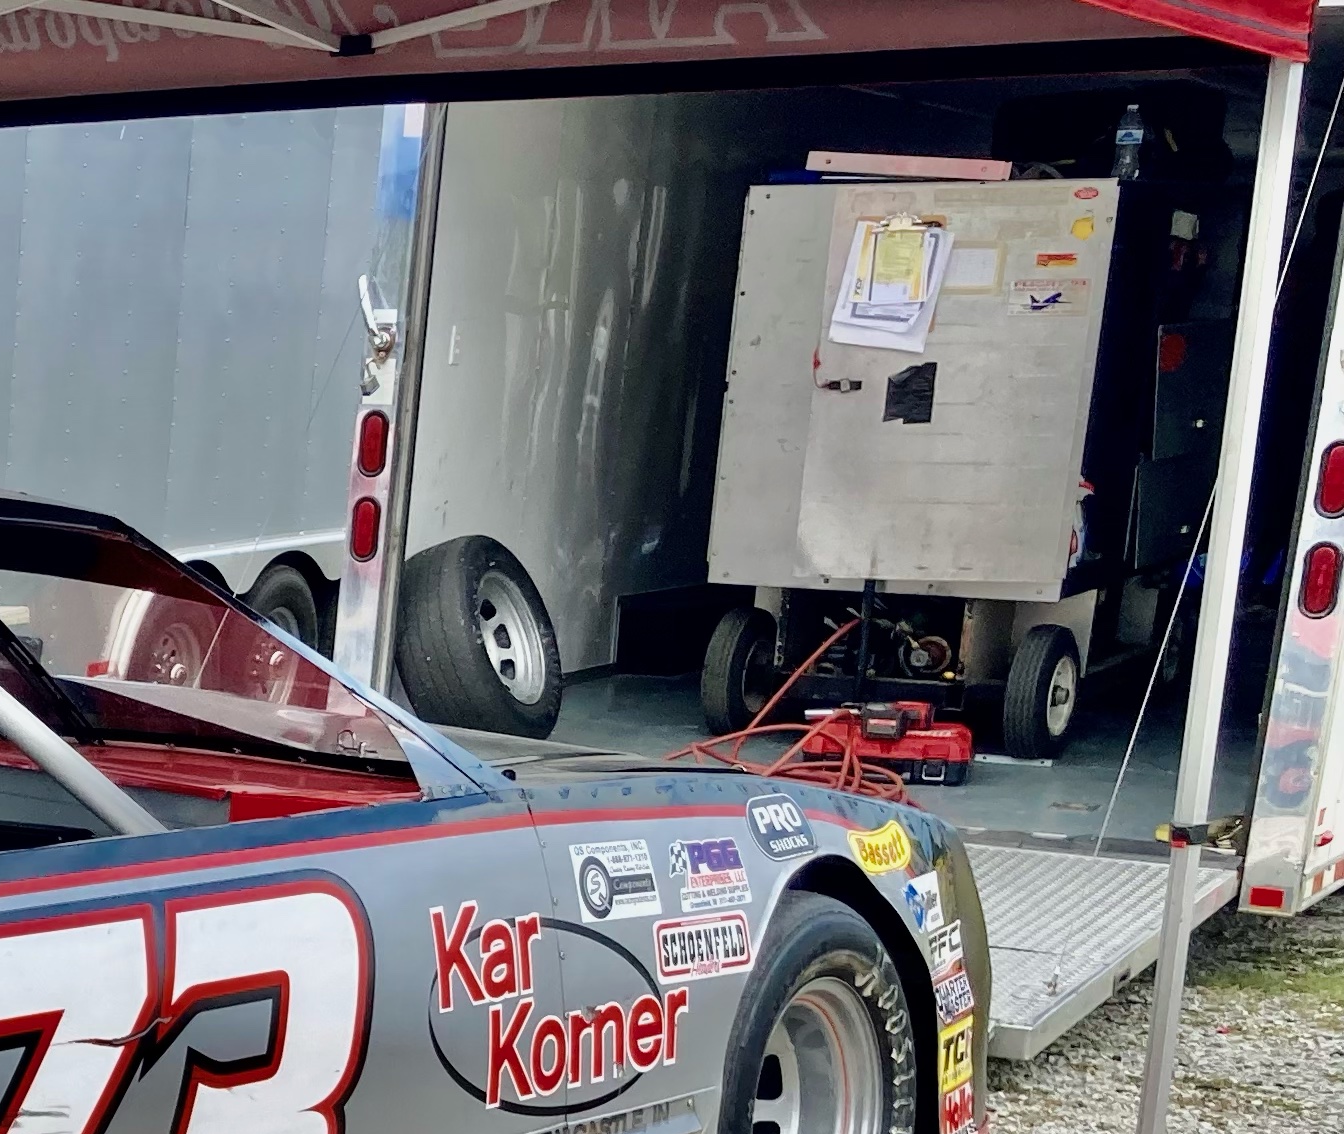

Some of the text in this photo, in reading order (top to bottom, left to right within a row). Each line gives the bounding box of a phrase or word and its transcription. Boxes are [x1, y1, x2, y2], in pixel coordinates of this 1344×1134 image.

[752, 803, 802, 834] PRO
[769, 834, 809, 853] SHOCKS
[855, 829, 905, 867] Bassett
[429, 900, 542, 1014] Kar
[662, 924, 745, 967] SCHOENFELD
[485, 987, 689, 1109] Korner
[653, 1101, 670, 1127] IN
